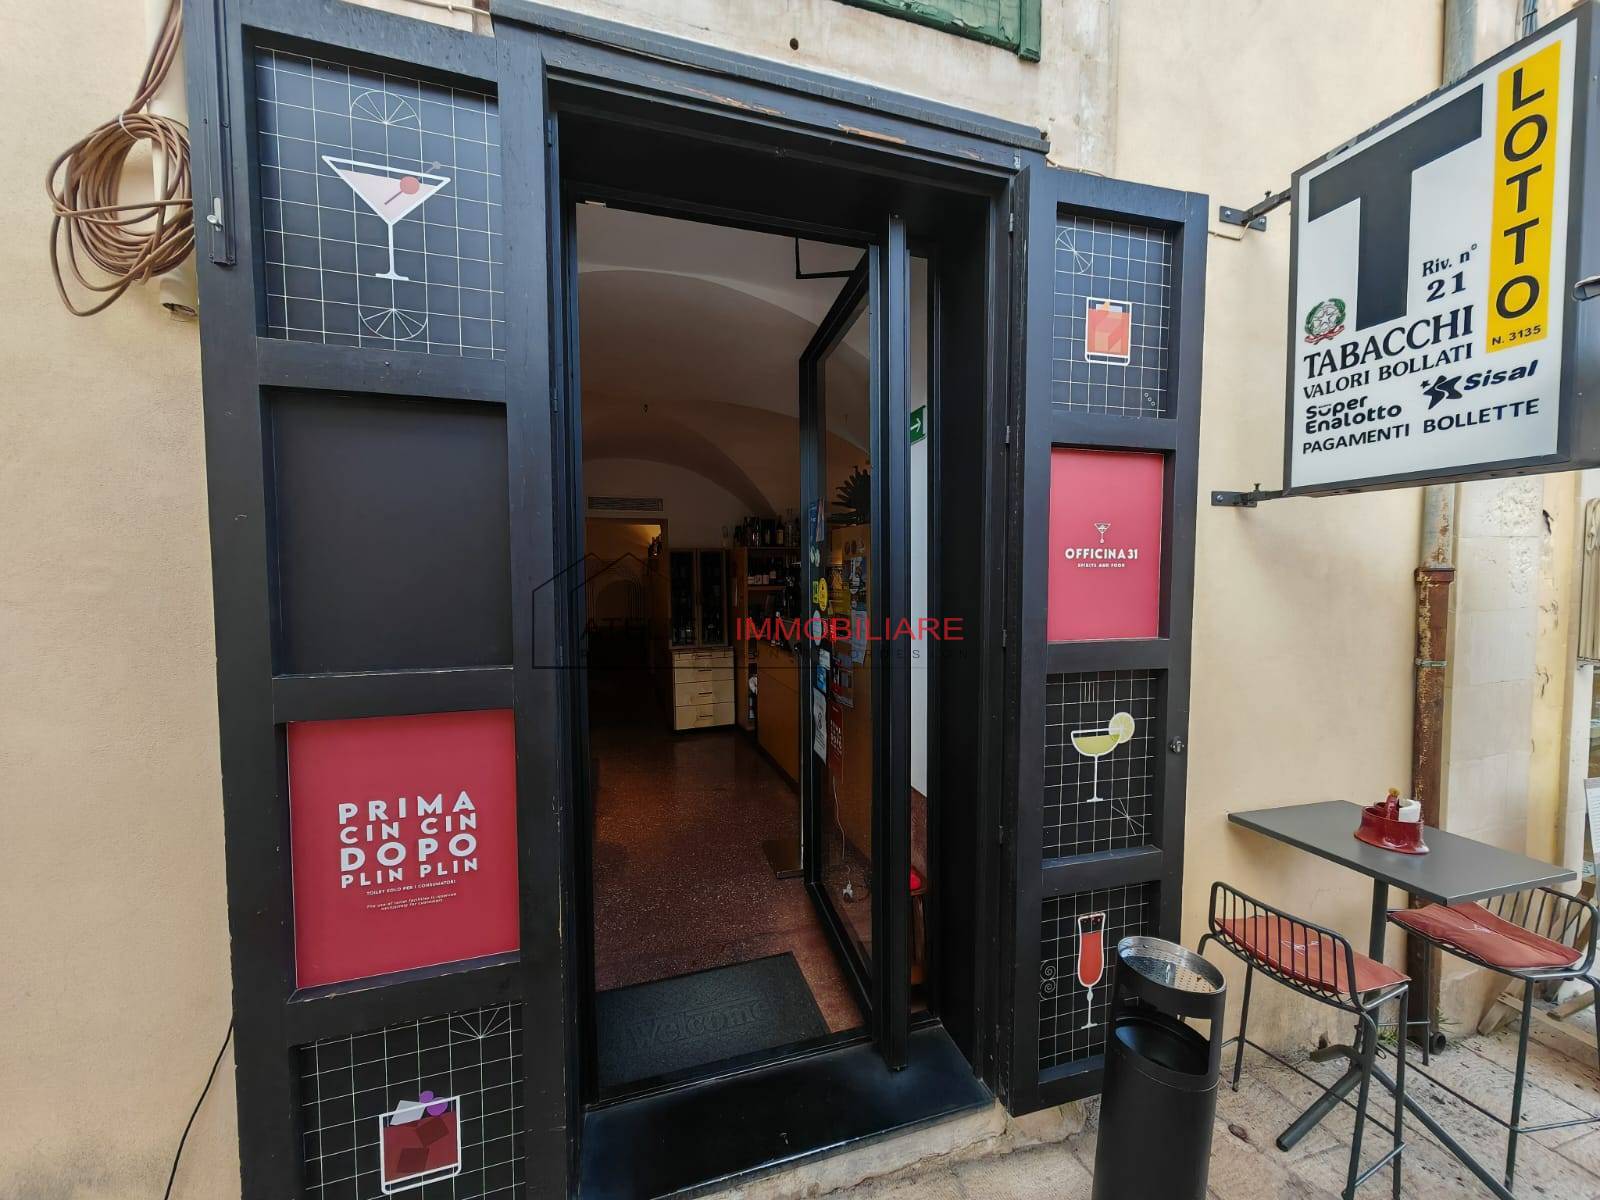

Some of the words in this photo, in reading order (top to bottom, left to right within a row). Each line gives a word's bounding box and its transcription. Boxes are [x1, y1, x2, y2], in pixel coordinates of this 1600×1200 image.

[1496, 67, 1548, 319] LOTTO
[1422, 257, 1453, 277] Riv.
[1426, 272, 1467, 302] 21
[1303, 304, 1474, 379] TABACCHI
[1492, 336, 1505, 346] N.
[1509, 326, 1541, 341] 3135
[1303, 370, 1370, 399] VALORI
[1378, 342, 1473, 381] BOLLATI
[1463, 359, 1538, 391] Sisal
[1302, 424, 1410, 454] PAGAMENTI
[1423, 398, 1540, 433] BOLLETTE
[1306, 404, 1402, 434] Enalotto
[338, 790, 476, 825] PRIMA
[340, 821, 400, 844] CIN
[420, 812, 477, 835] CIN
[340, 833, 477, 872] DOPO
[341, 867, 403, 889] PLIN
[420, 858, 477, 878] PLIN
[628, 1000, 771, 1049] Welcome
